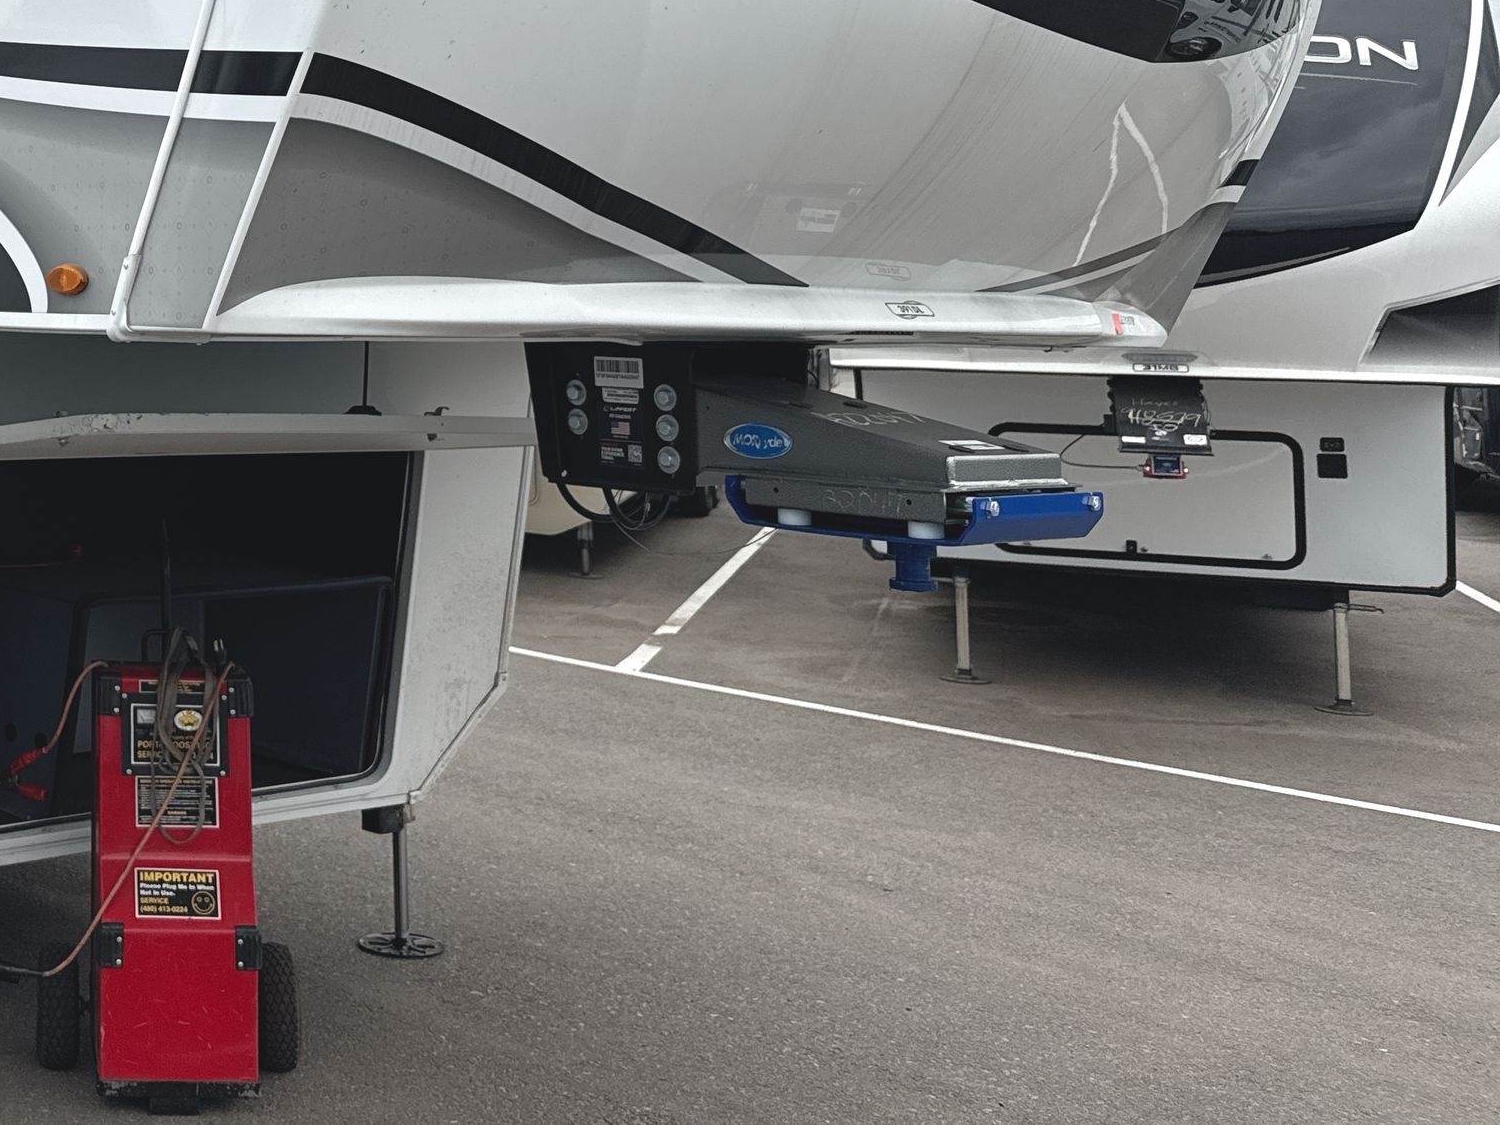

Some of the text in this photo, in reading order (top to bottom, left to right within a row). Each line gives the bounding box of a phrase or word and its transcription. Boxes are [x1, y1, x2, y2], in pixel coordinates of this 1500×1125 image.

[1303, 35, 1419, 70] ON
[139, 871, 215, 884] IMPORTANT
[162, 883, 177, 891] Plug
[139, 897, 170, 905] SERVICE
